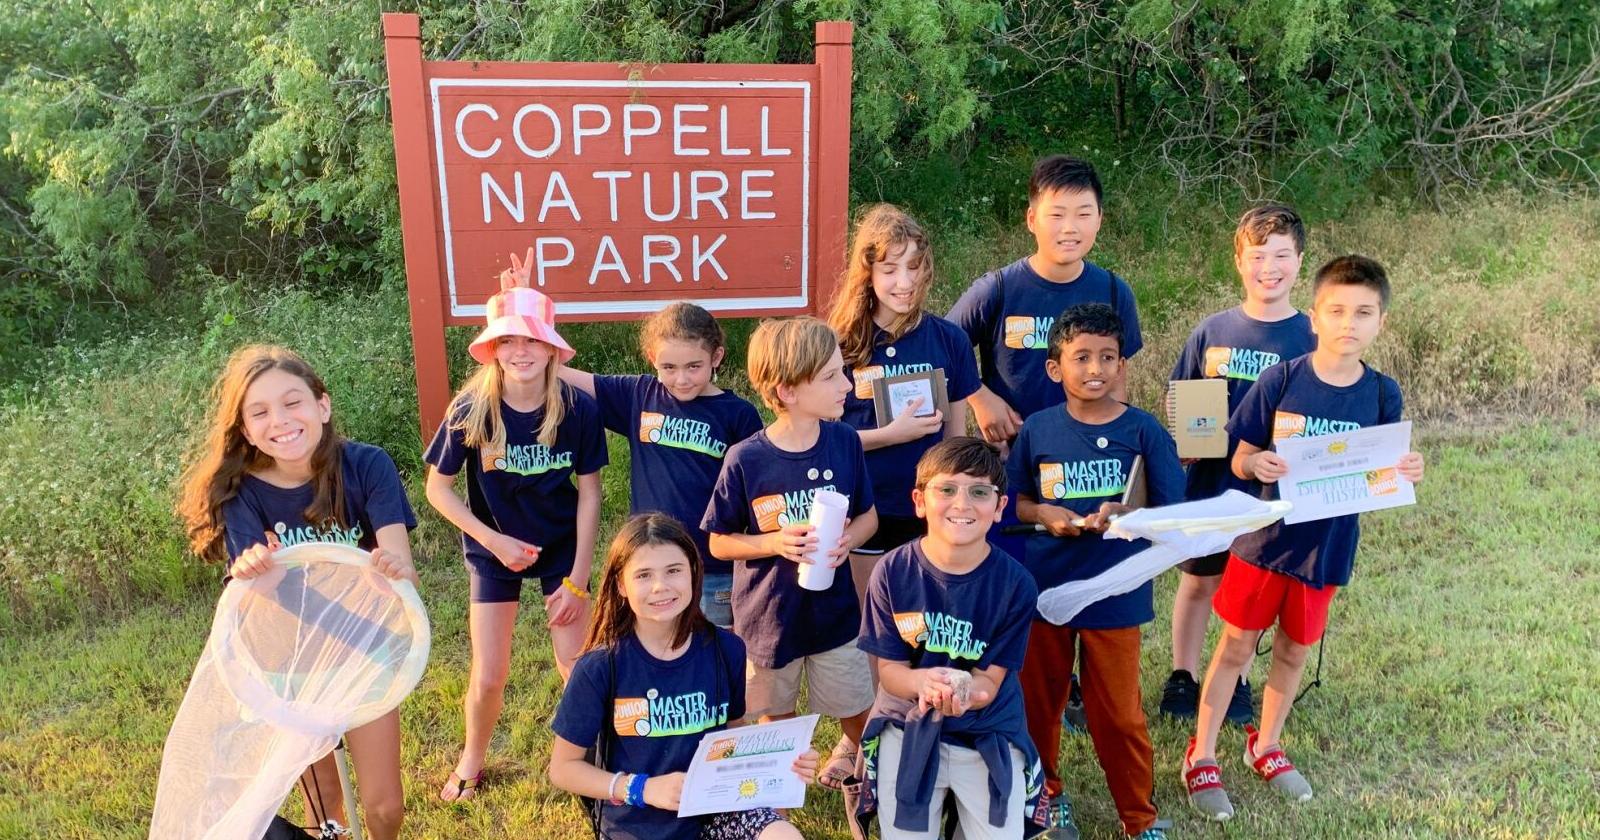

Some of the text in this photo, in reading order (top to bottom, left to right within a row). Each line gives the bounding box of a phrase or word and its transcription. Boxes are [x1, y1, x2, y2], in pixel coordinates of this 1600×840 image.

[454, 103, 792, 158] COPPELL
[481, 170, 776, 223] NATURE
[535, 233, 728, 287] PARK
[664, 415, 710, 436] MASTER
[506, 443, 551, 461] MASTER
[1064, 459, 1122, 480] MASTER
[755, 495, 786, 517] JUNIOR
[615, 691, 707, 718] JUNIOR MASTER
